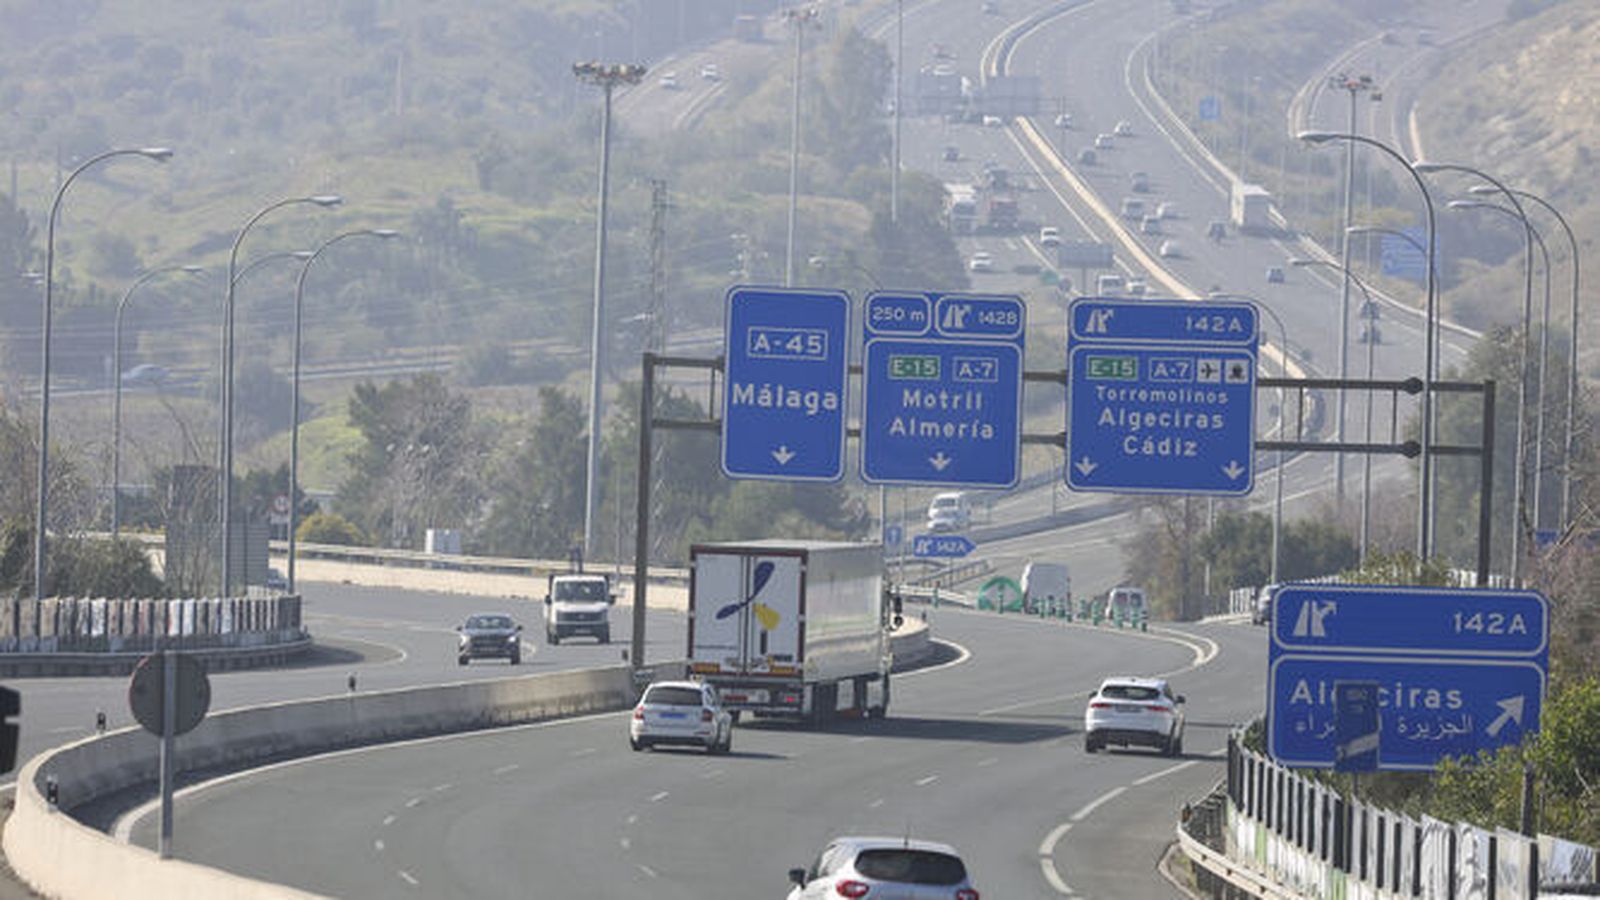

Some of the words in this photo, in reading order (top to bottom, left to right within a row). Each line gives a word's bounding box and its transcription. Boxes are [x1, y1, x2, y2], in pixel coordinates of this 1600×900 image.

[872, 306, 905, 321] 250
[910, 310, 926, 322] m
[1185, 316, 1243, 333] 142A
[753, 333, 822, 355] A-45
[892, 359, 937, 376] E-15
[959, 363, 993, 378] A-7
[1090, 359, 1133, 376] E-15
[1153, 362, 1189, 378] A-7
[731, 383, 838, 416] Málaga
[902, 389, 982, 411] Motril
[1096, 385, 1229, 404] Torremolinos
[889, 417, 994, 440] Almería
[1097, 406, 1224, 431] Algeciras
[1123, 435, 1198, 456] Cádiz
[1454, 612, 1528, 635] 142A
